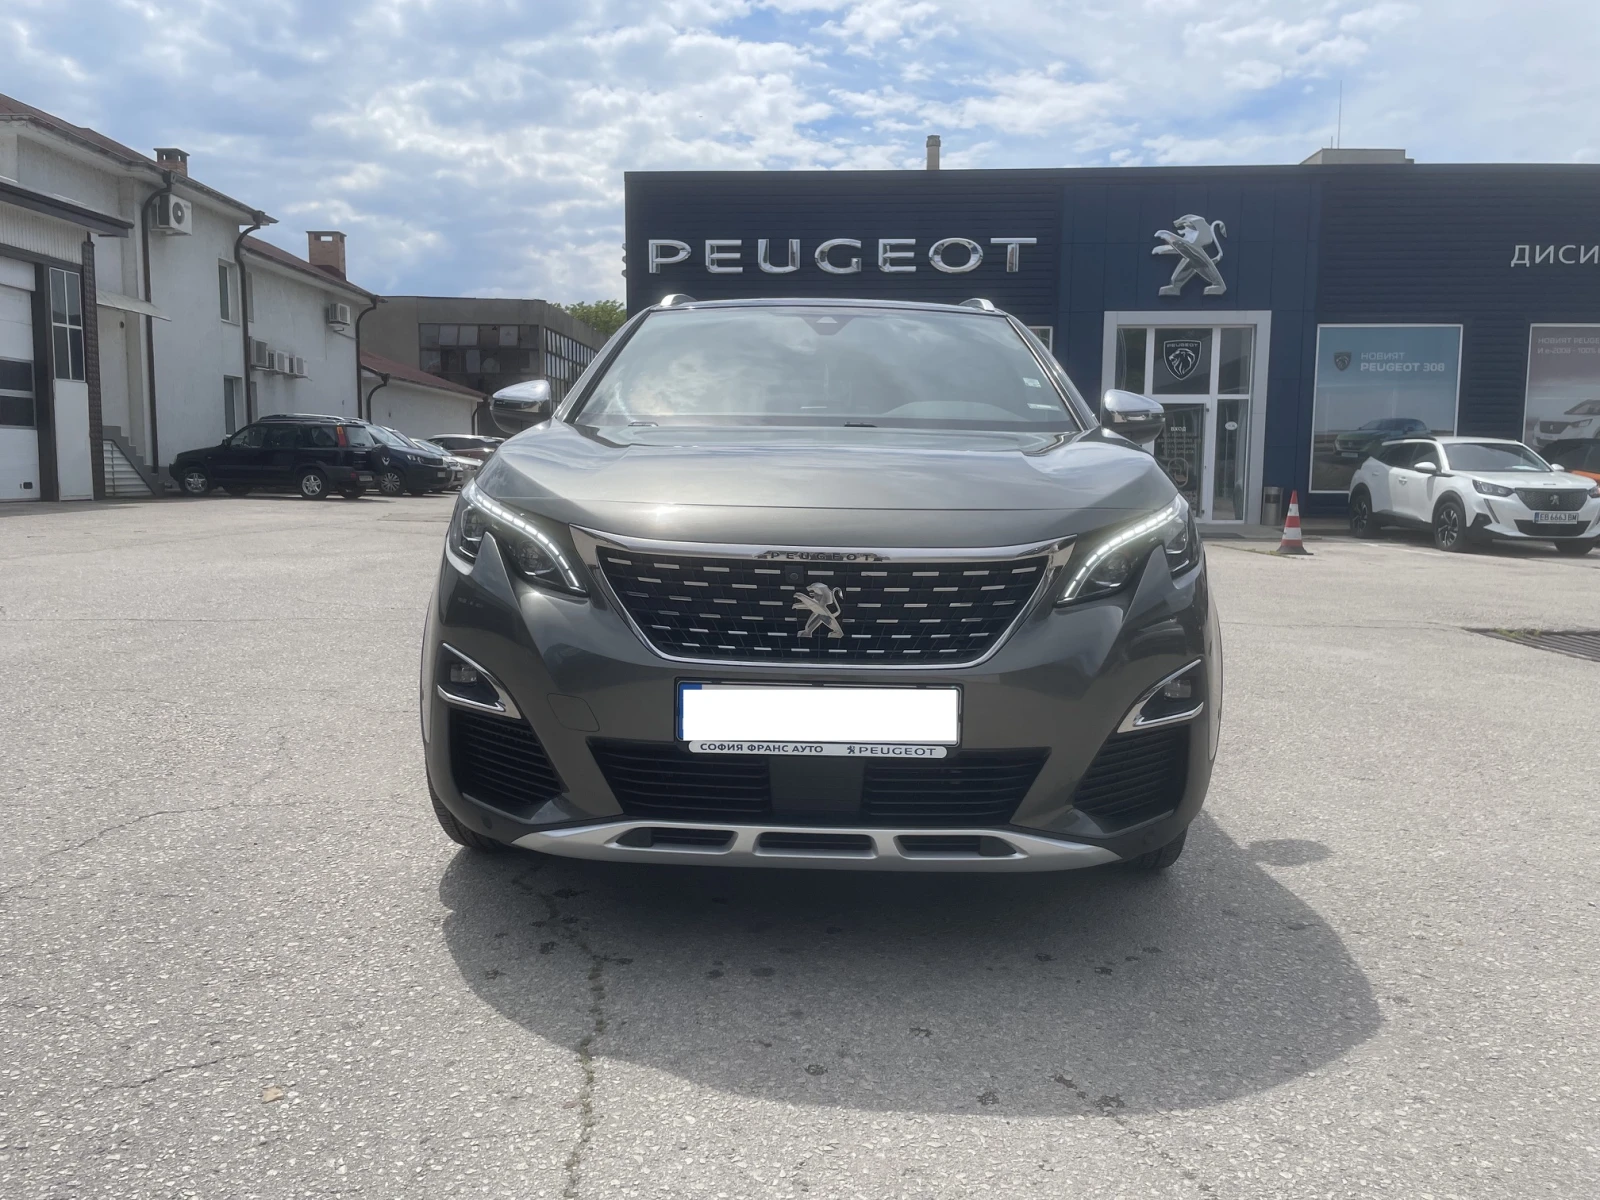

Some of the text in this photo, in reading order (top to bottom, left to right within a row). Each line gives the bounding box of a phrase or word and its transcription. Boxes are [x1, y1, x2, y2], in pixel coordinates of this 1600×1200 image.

[648, 237, 1038, 275] PEUGEOT
[1510, 244, 1599, 268] ДИСИ
[1360, 352, 1405, 360] НОВИЯТ
[1360, 362, 1445, 372] PEUGEOT 308
[770, 552, 873, 561] PEUGEOT
[700, 743, 824, 754] СОФИЯ ФРАНС АУТО
[858, 747, 937, 756] PEUGEOT
